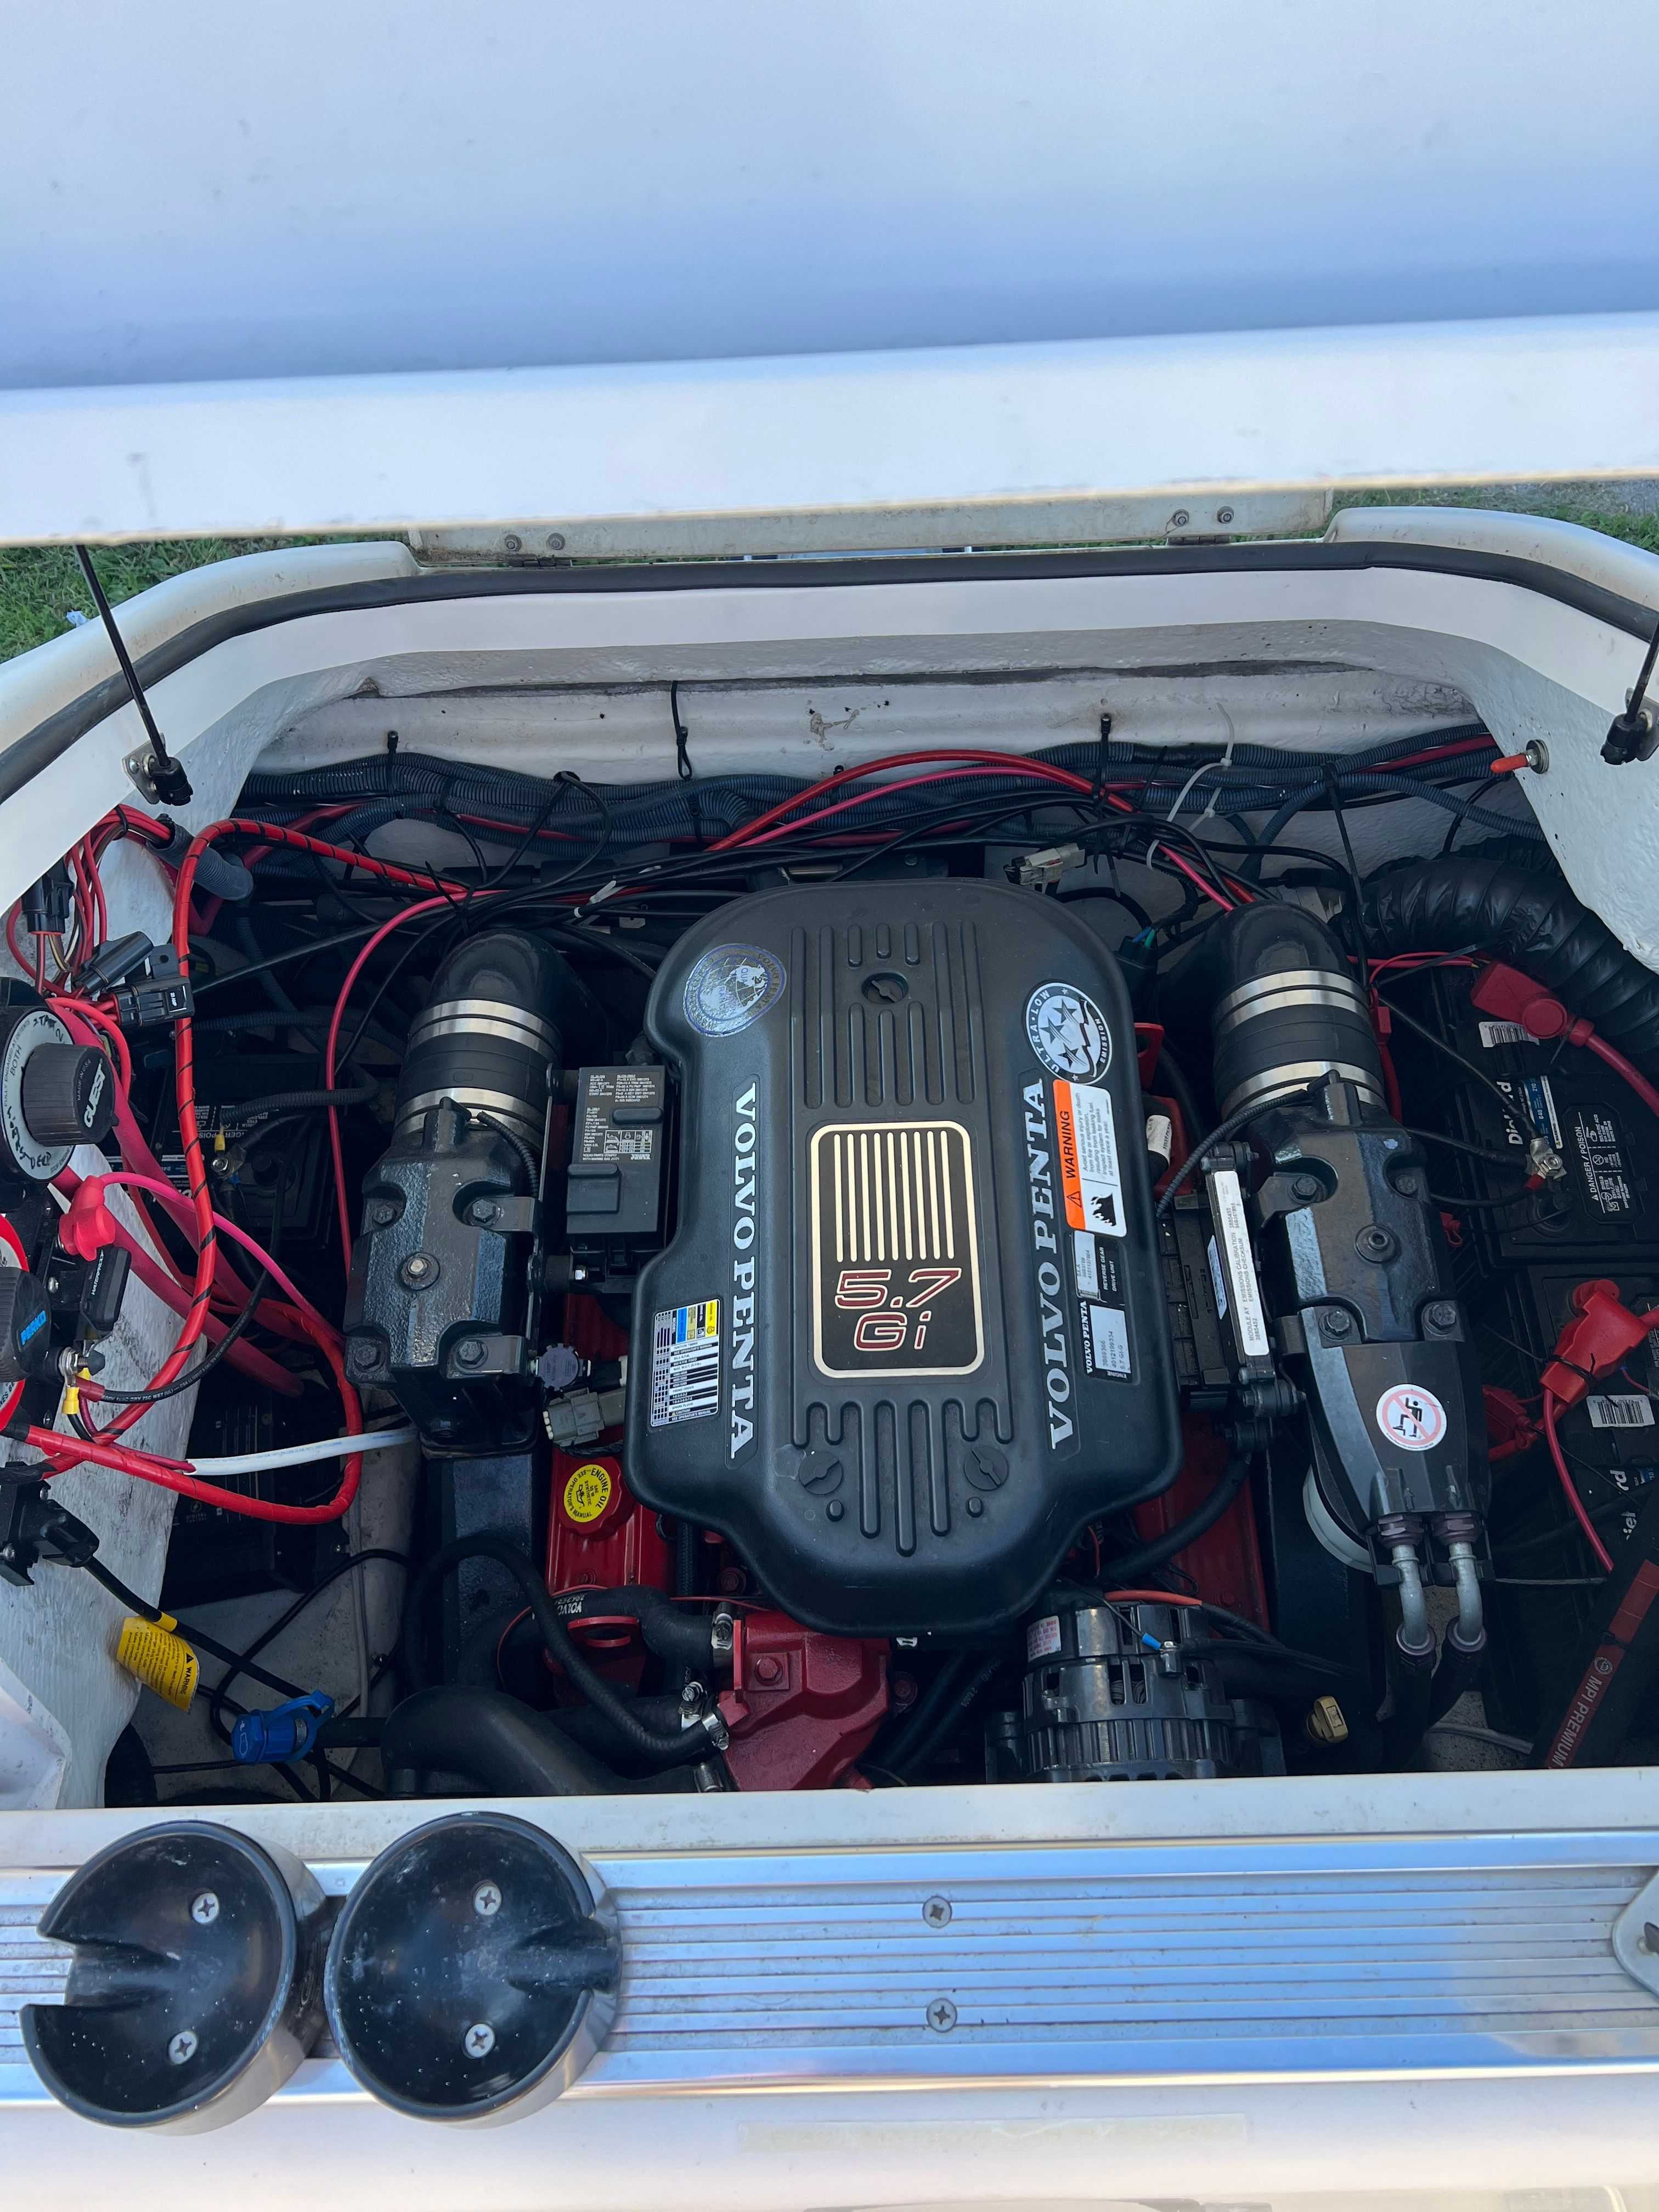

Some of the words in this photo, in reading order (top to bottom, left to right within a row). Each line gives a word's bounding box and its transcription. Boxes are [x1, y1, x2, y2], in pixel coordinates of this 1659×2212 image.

[1031, 990, 1050, 1015] LOW
[10, 1045, 22, 1076] BOTH
[1030, 1024, 1060, 1073] ULTRA
[84, 1063, 105, 1128] GUEST
[1060, 1110, 1076, 1179] WARNING
[1575, 1126, 1587, 1154] POISON
[734, 1082, 757, 1250] VOLVO
[1023, 1078, 1057, 1254] PENTA
[1584, 1162, 1597, 1193] DANGER
[1231, 1233, 1242, 1269] CALIBRATION
[1238, 1238, 1248, 1269] CHECKSUM
[835, 1267, 962, 1310] 5.7
[1238, 1271, 1248, 1302] EMISSIONS
[1244, 1271, 1254, 1301] EMISSIONS
[1080, 1300, 1090, 1339] PENTA
[1244, 1307, 1250, 1315] AY
[21, 1310, 47, 1346] PERKO
[854, 1310, 932, 1352] Gi
[1245, 1317, 1254, 1341] MODULE
[731, 1256, 755, 1459] PENTA
[1038, 1262, 1073, 1450] VOLVO
[1084, 1340, 1093, 1374] VOLVO
[577, 1469, 586, 1479] SEE
[591, 1468, 608, 1493] ENGINE
[567, 1477, 578, 1511] OPERATOR'S
[595, 1496, 606, 1509] OIL
[572, 1509, 592, 1518] MANUAL
[180, 1667, 192, 1695] WARNING
[1582, 1675, 1602, 1702] MPI
[1552, 1702, 1589, 1767] PREMIUM
